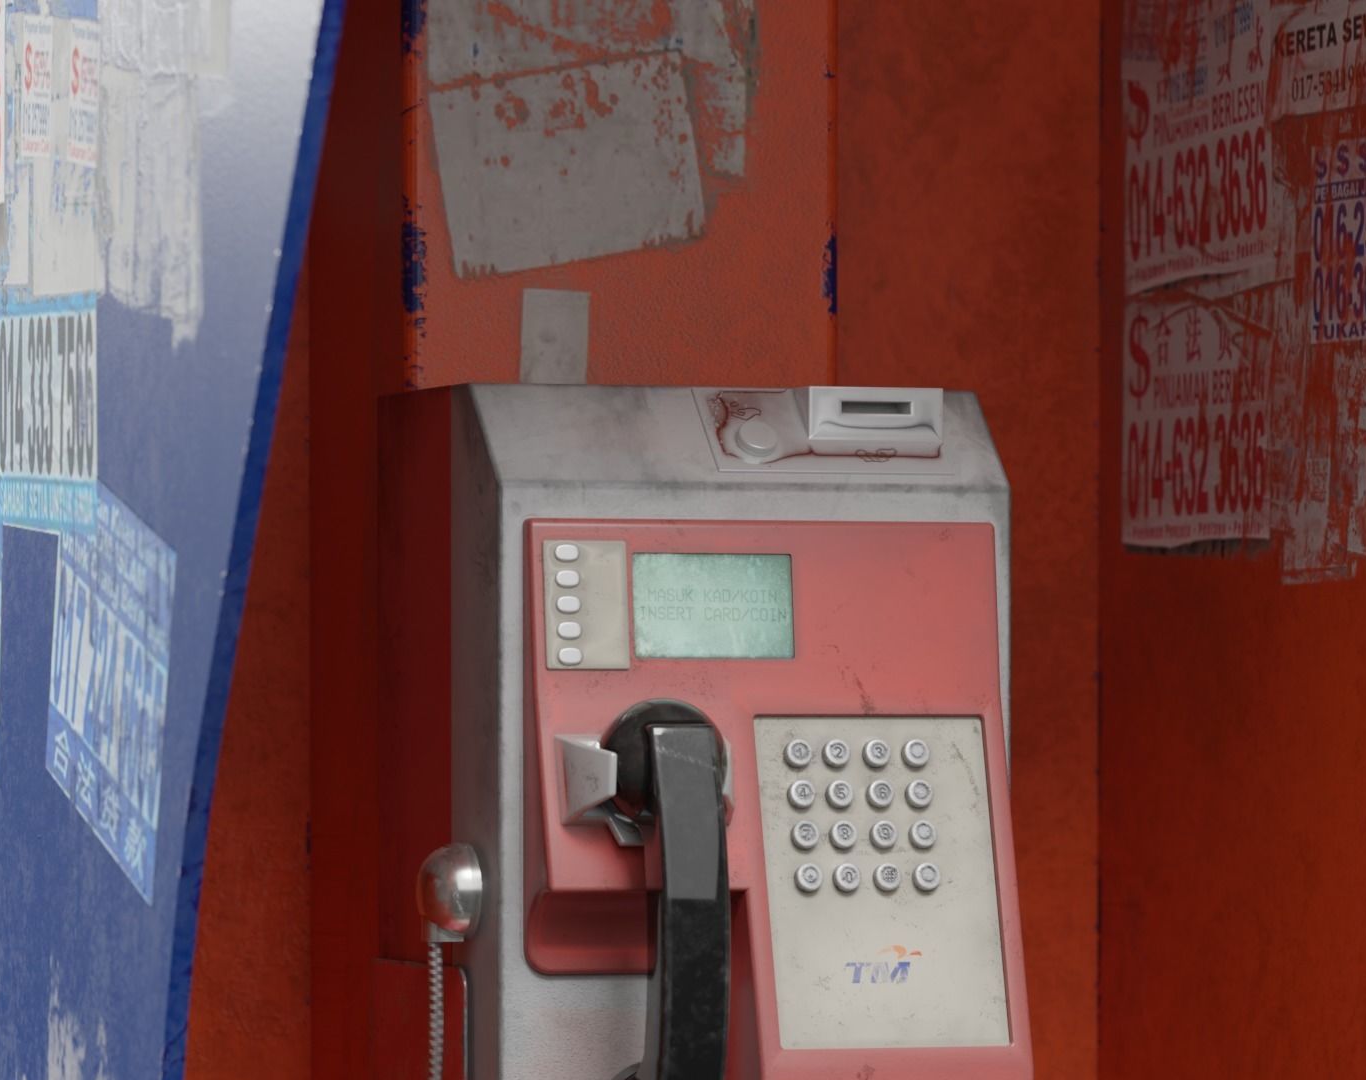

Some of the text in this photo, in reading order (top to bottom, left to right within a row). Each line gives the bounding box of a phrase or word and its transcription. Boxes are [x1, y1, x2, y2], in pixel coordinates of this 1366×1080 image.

[1274, 21, 1337, 57] KERETA
[1212, 80, 1264, 131] BERLESEN
[1129, 127, 1267, 262] 014-632 3636
[1315, 184, 1359, 201] PEBAGAI
[0, 317, 24, 473] 014
[27, 315, 53, 475] 333
[1212, 368, 1265, 404] BERESEN
[1128, 416, 1209, 519] 014-632
[1215, 411, 1265, 514] 3636
[647, 588, 777, 603] MASUK KAD/KOIN
[639, 606, 787, 623] INSERT CARD/COIN
